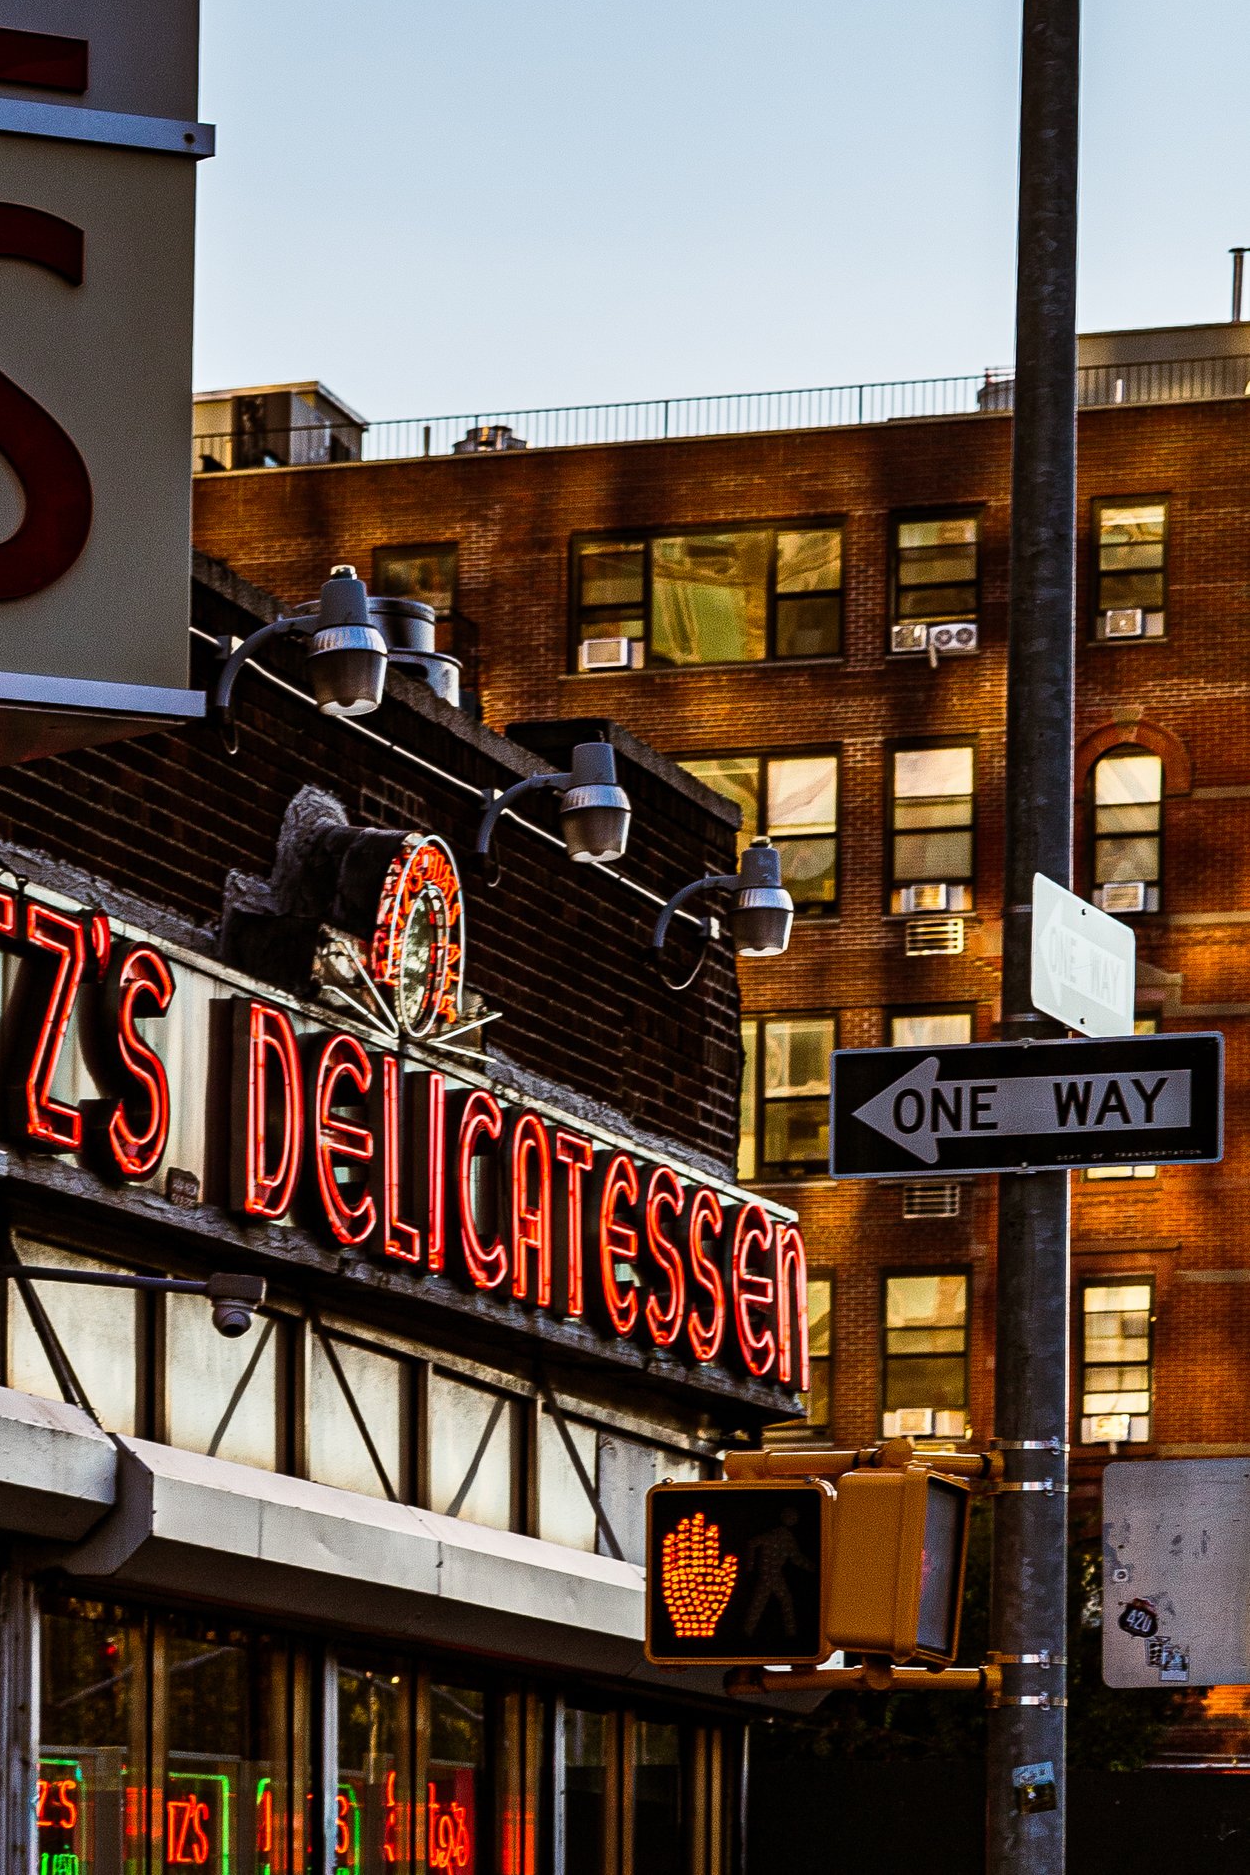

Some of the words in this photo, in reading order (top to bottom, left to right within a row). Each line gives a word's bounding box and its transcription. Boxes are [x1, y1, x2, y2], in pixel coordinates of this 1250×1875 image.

[892, 1084, 999, 1135] ONE
[1052, 1077, 1169, 1128] WAY
[1115, 1149, 1202, 1158] TRANSPORTATION
[244, 998, 810, 1392] DELICATESSEN
